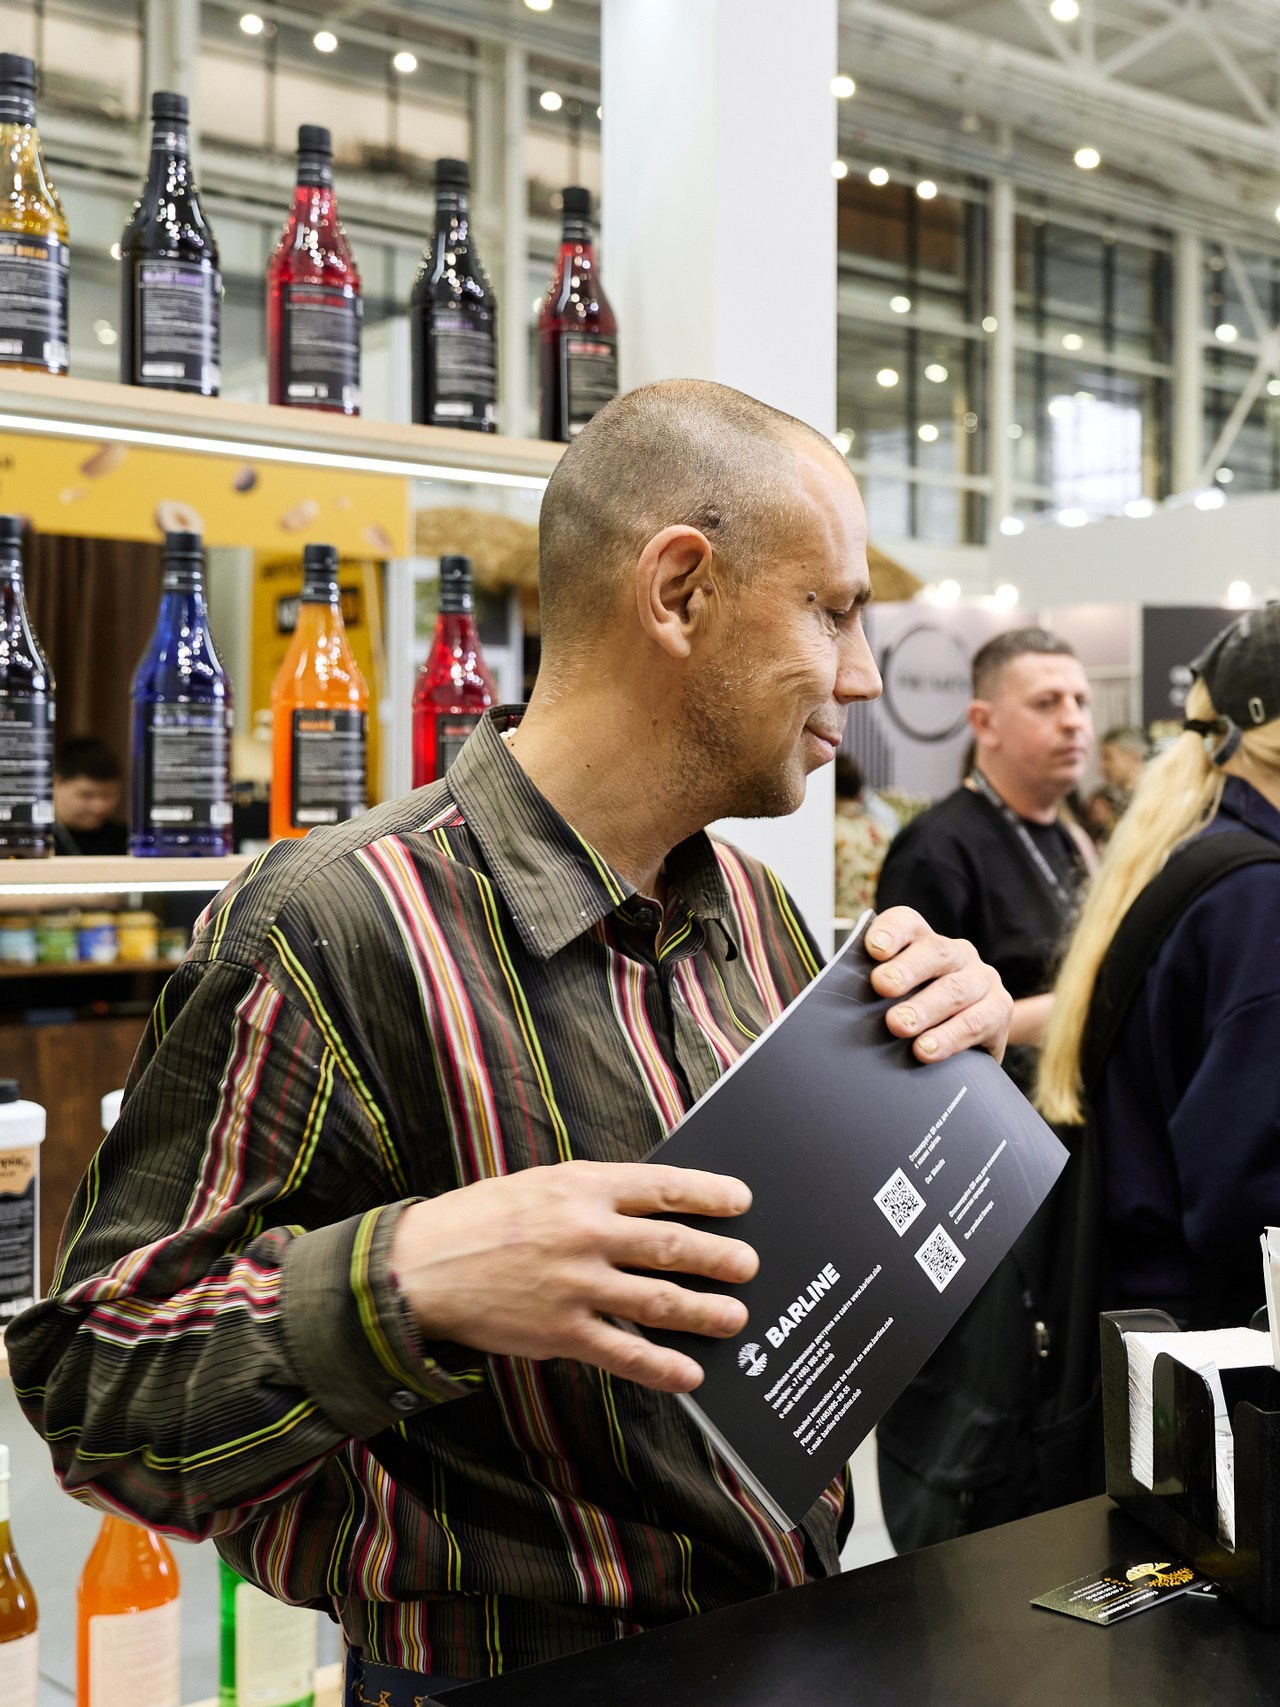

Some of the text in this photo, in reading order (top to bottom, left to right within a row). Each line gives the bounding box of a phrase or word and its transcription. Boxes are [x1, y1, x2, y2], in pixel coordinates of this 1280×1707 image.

[765, 1262, 841, 1349] BARLINE
[814, 1320, 835, 1345] доступна
[833, 1314, 841, 1323] на
[838, 1300, 852, 1316] сайте
[850, 1264, 882, 1302] www.barline.club
[793, 1415, 813, 1438] Detailed
[832, 1380, 842, 1391] can
[839, 1373, 847, 1382] be
[844, 1359, 859, 1376] found
[856, 1354, 864, 1362] on
[862, 1317, 894, 1356] www.barline.club
[800, 1428, 817, 1447] Phone:
